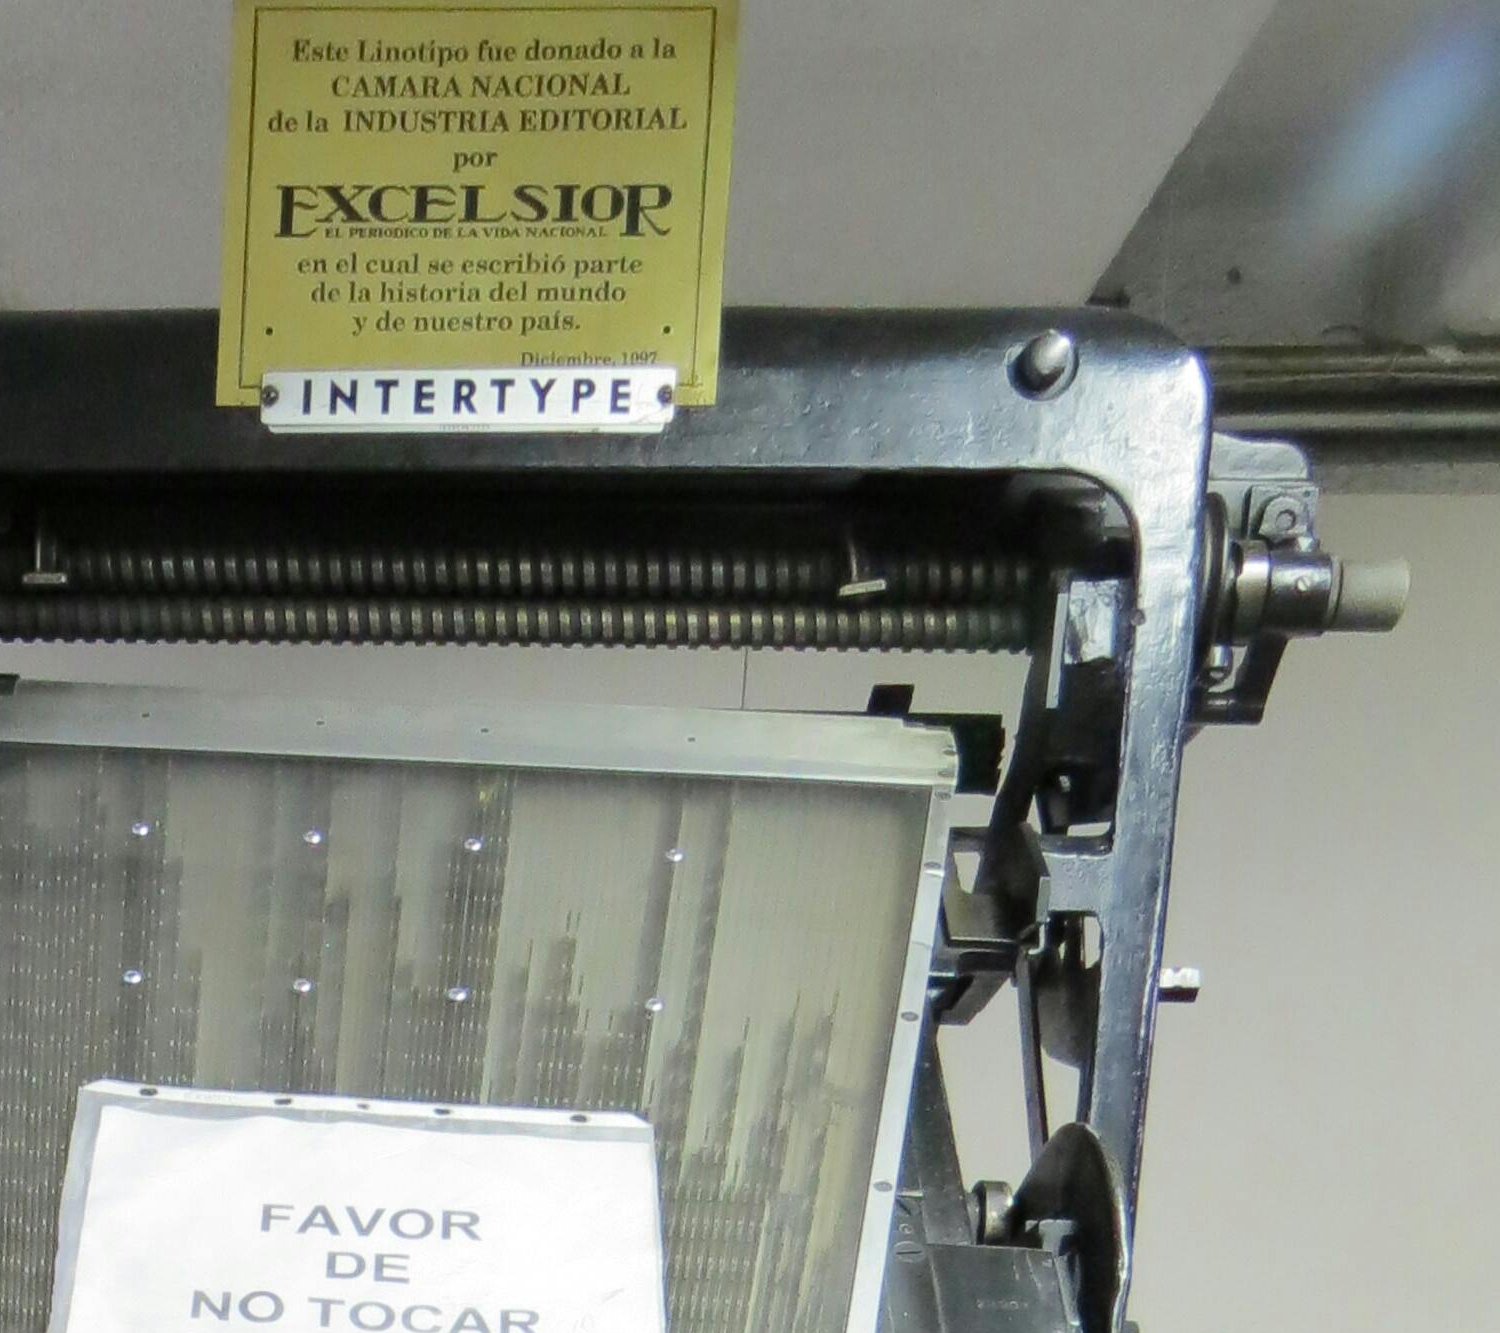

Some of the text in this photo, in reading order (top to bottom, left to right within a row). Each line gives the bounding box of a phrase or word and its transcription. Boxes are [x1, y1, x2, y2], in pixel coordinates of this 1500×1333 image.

[292, 39, 349, 62] Este
[478, 39, 516, 62] fue
[525, 37, 622, 61] donado
[630, 44, 644, 59] a
[653, 37, 676, 59] la
[331, 73, 630, 98] CAMARA NACIONAL
[268, 107, 687, 133] de la INDUSTRIA EDITORIAL
[453, 152, 498, 173] por
[274, 184, 672, 238] EXCELSIOR
[297, 252, 642, 279] en el cual se escribió parte
[311, 281, 626, 303] de la historia del mundo
[352, 309, 581, 337] y de nuestro país.
[302, 378, 630, 415] INTERTYPE
[260, 1204, 480, 1241] FAVOR
[325, 1251, 410, 1284] DE
[191, 1290, 285, 1323] NO
